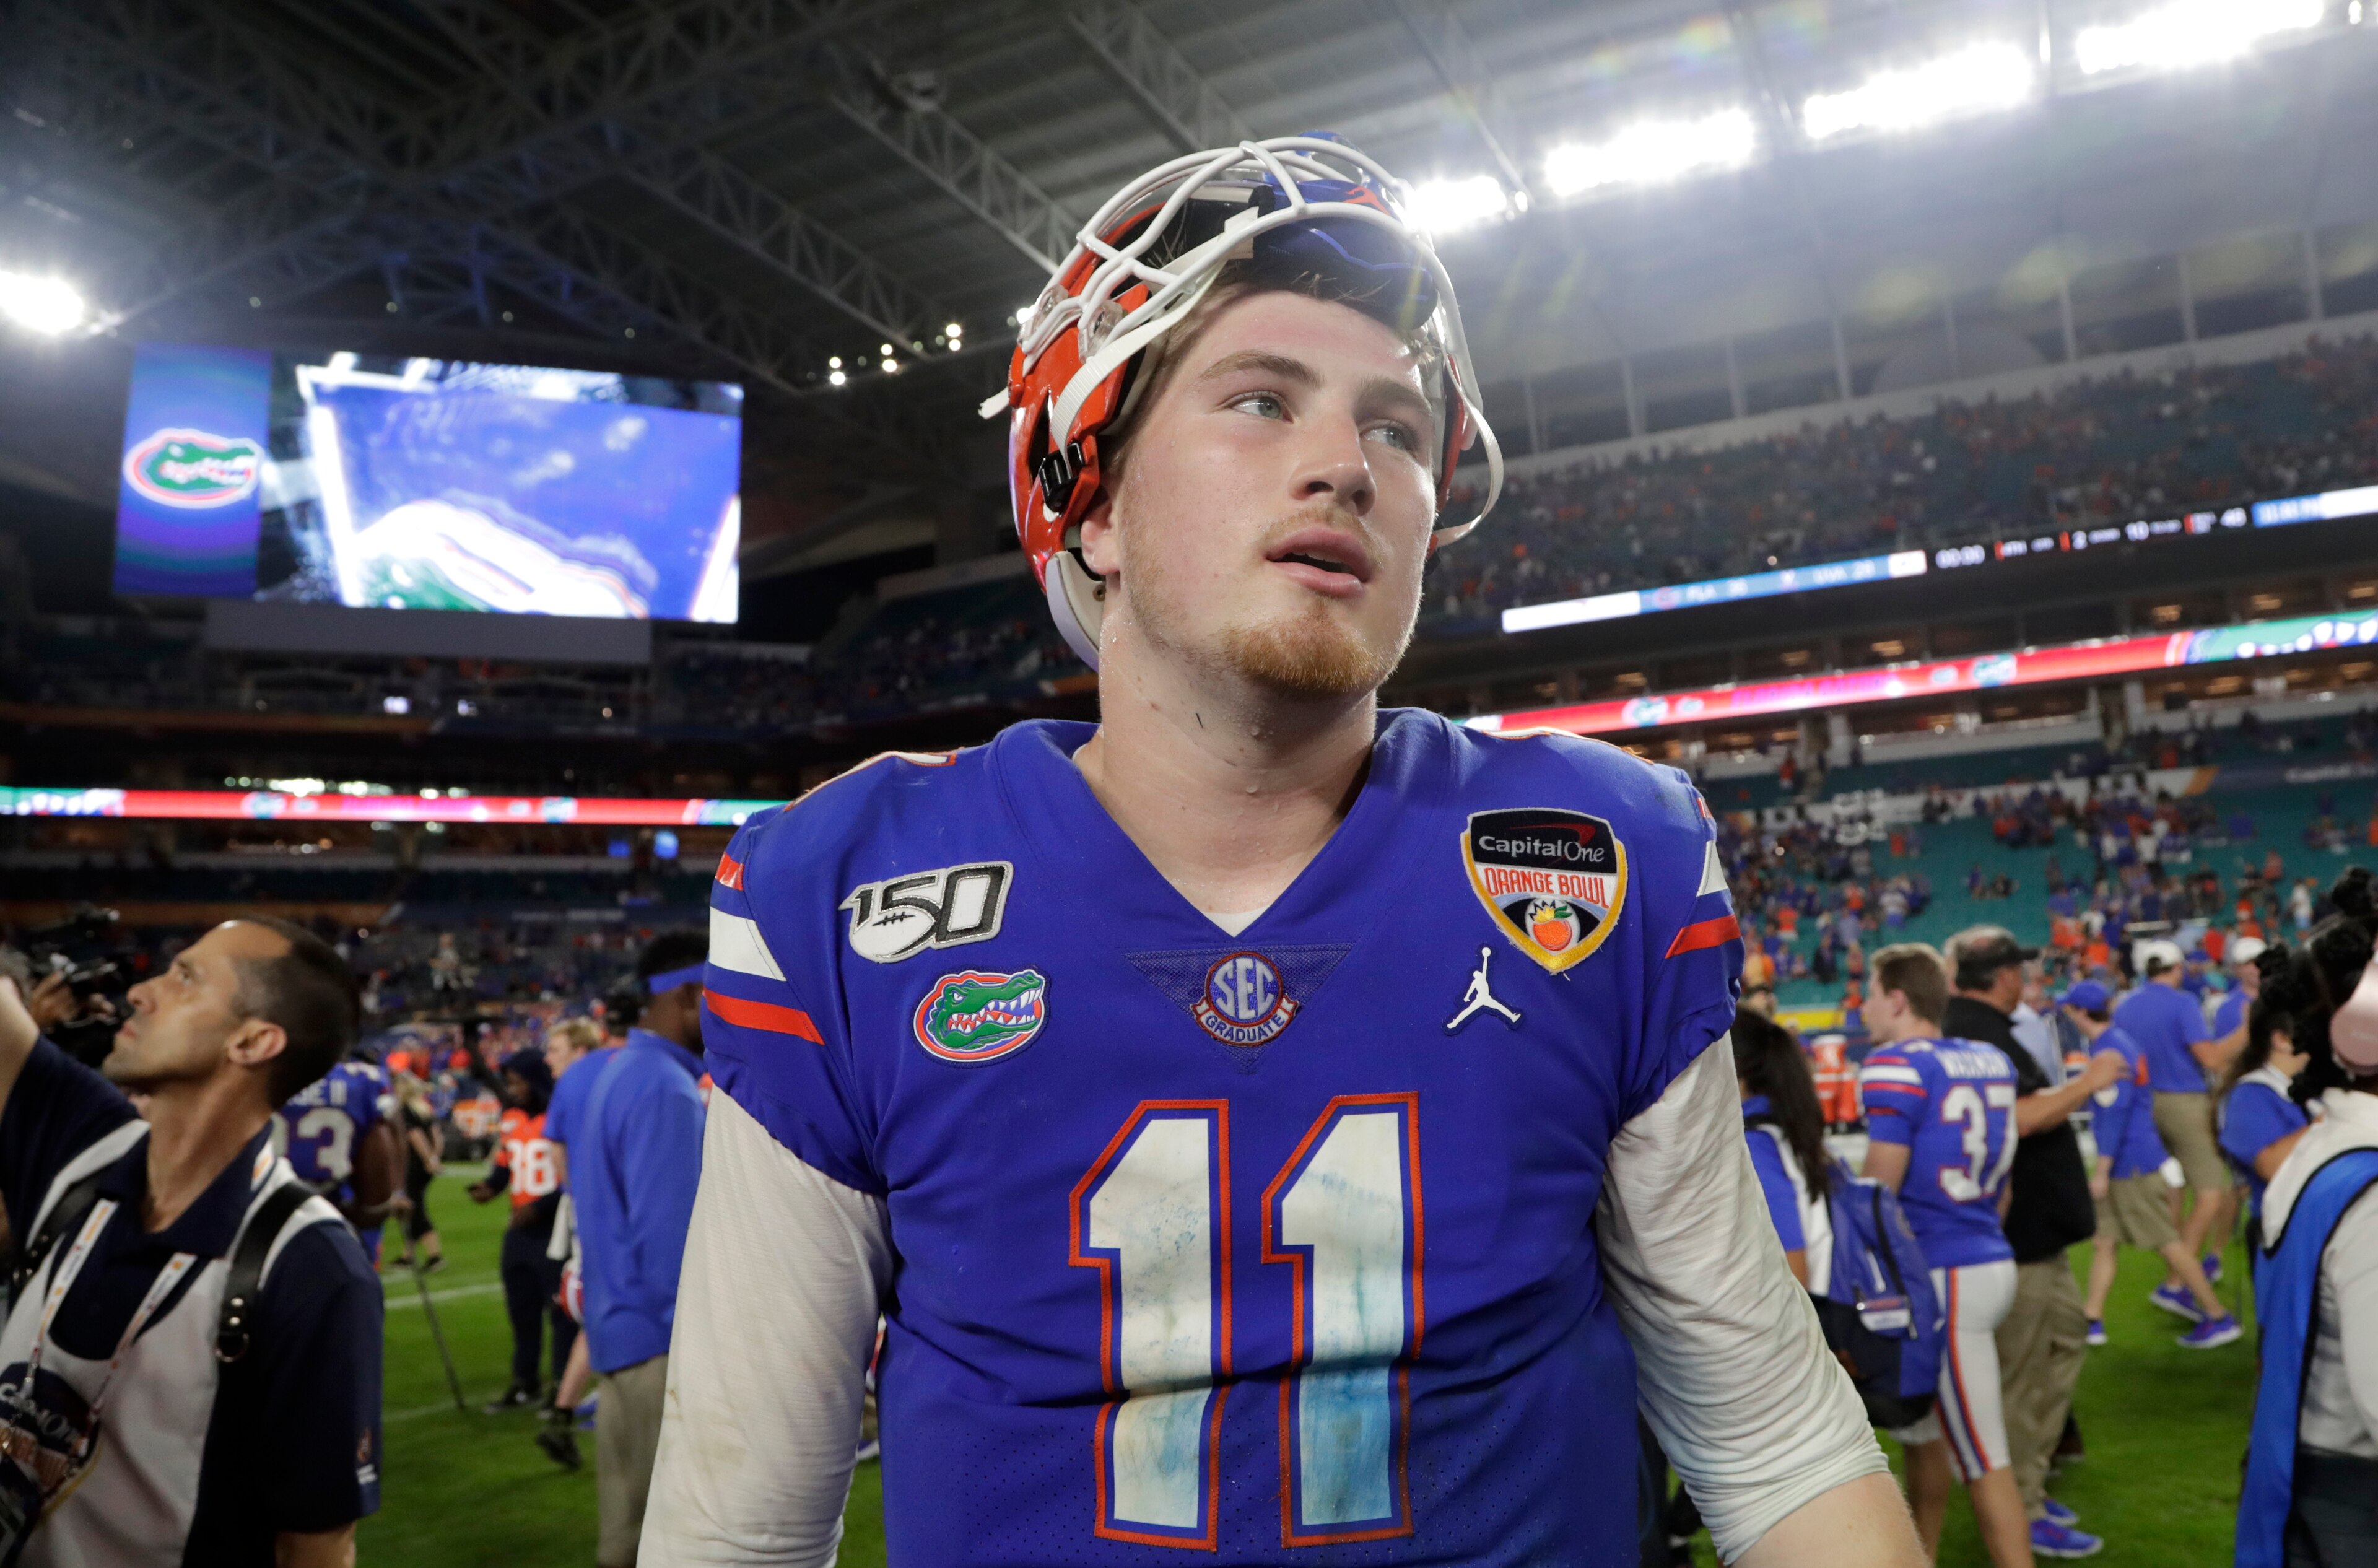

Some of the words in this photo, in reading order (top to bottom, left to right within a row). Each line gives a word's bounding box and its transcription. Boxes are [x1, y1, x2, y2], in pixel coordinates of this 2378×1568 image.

[2072, 530, 2088, 550] 2
[2125, 521, 2149, 541] 10
[849, 864, 1008, 959] 150
[1484, 867, 1553, 897] ORANGE
[1558, 874, 1610, 909] BOWL
[1213, 957, 1274, 1020] SEC
[1204, 1013, 1285, 1042] GRADUATE
[1939, 1084, 2017, 1201] 37
[1069, 1091, 1425, 1553] 11
